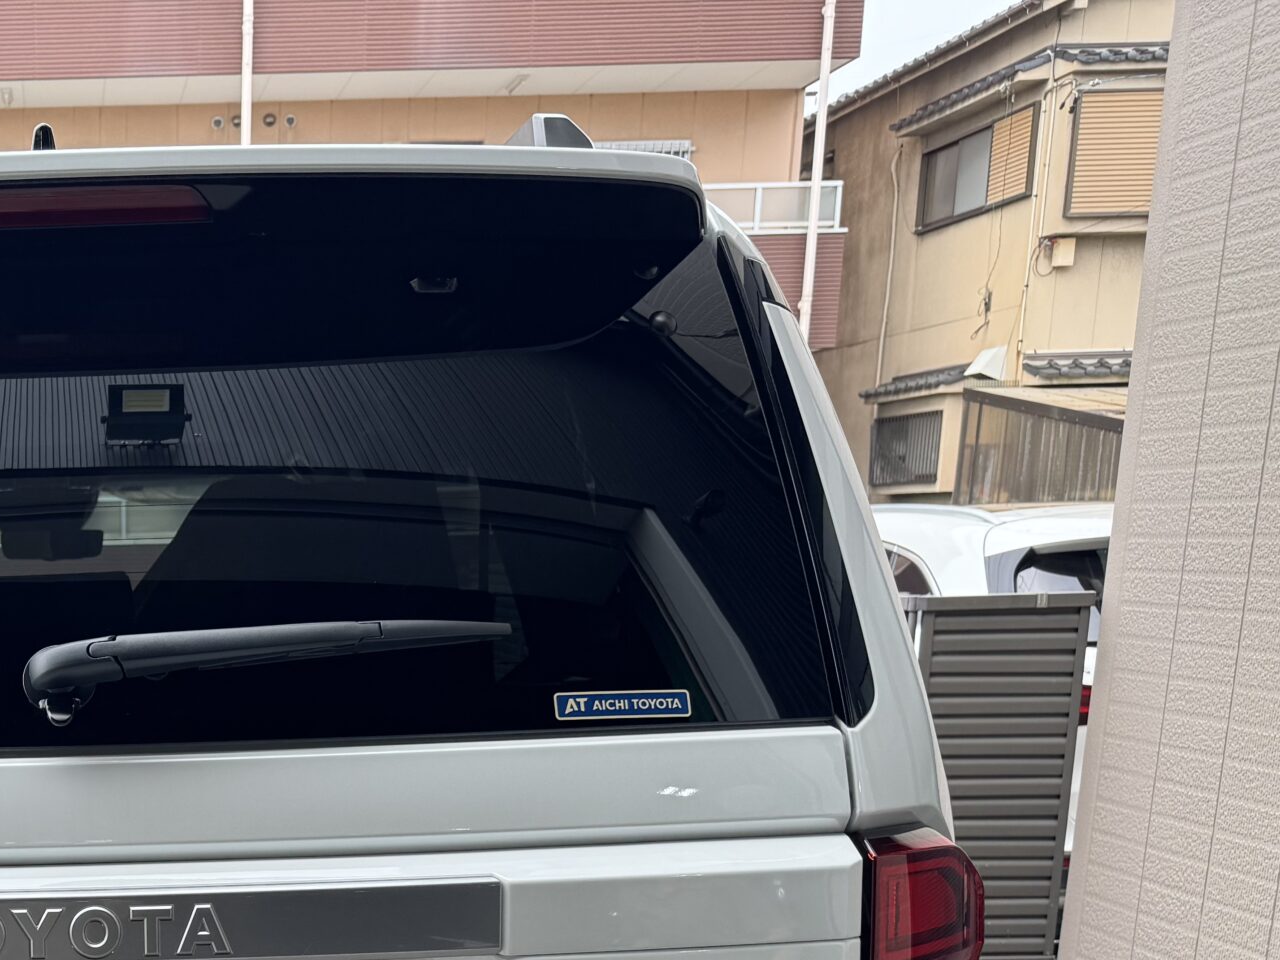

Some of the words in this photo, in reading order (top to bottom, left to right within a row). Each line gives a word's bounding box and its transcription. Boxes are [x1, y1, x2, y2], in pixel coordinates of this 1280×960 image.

[564, 698, 588, 714] AT
[592, 699, 629, 711] AICHI
[631, 698, 682, 710] TOYOTA
